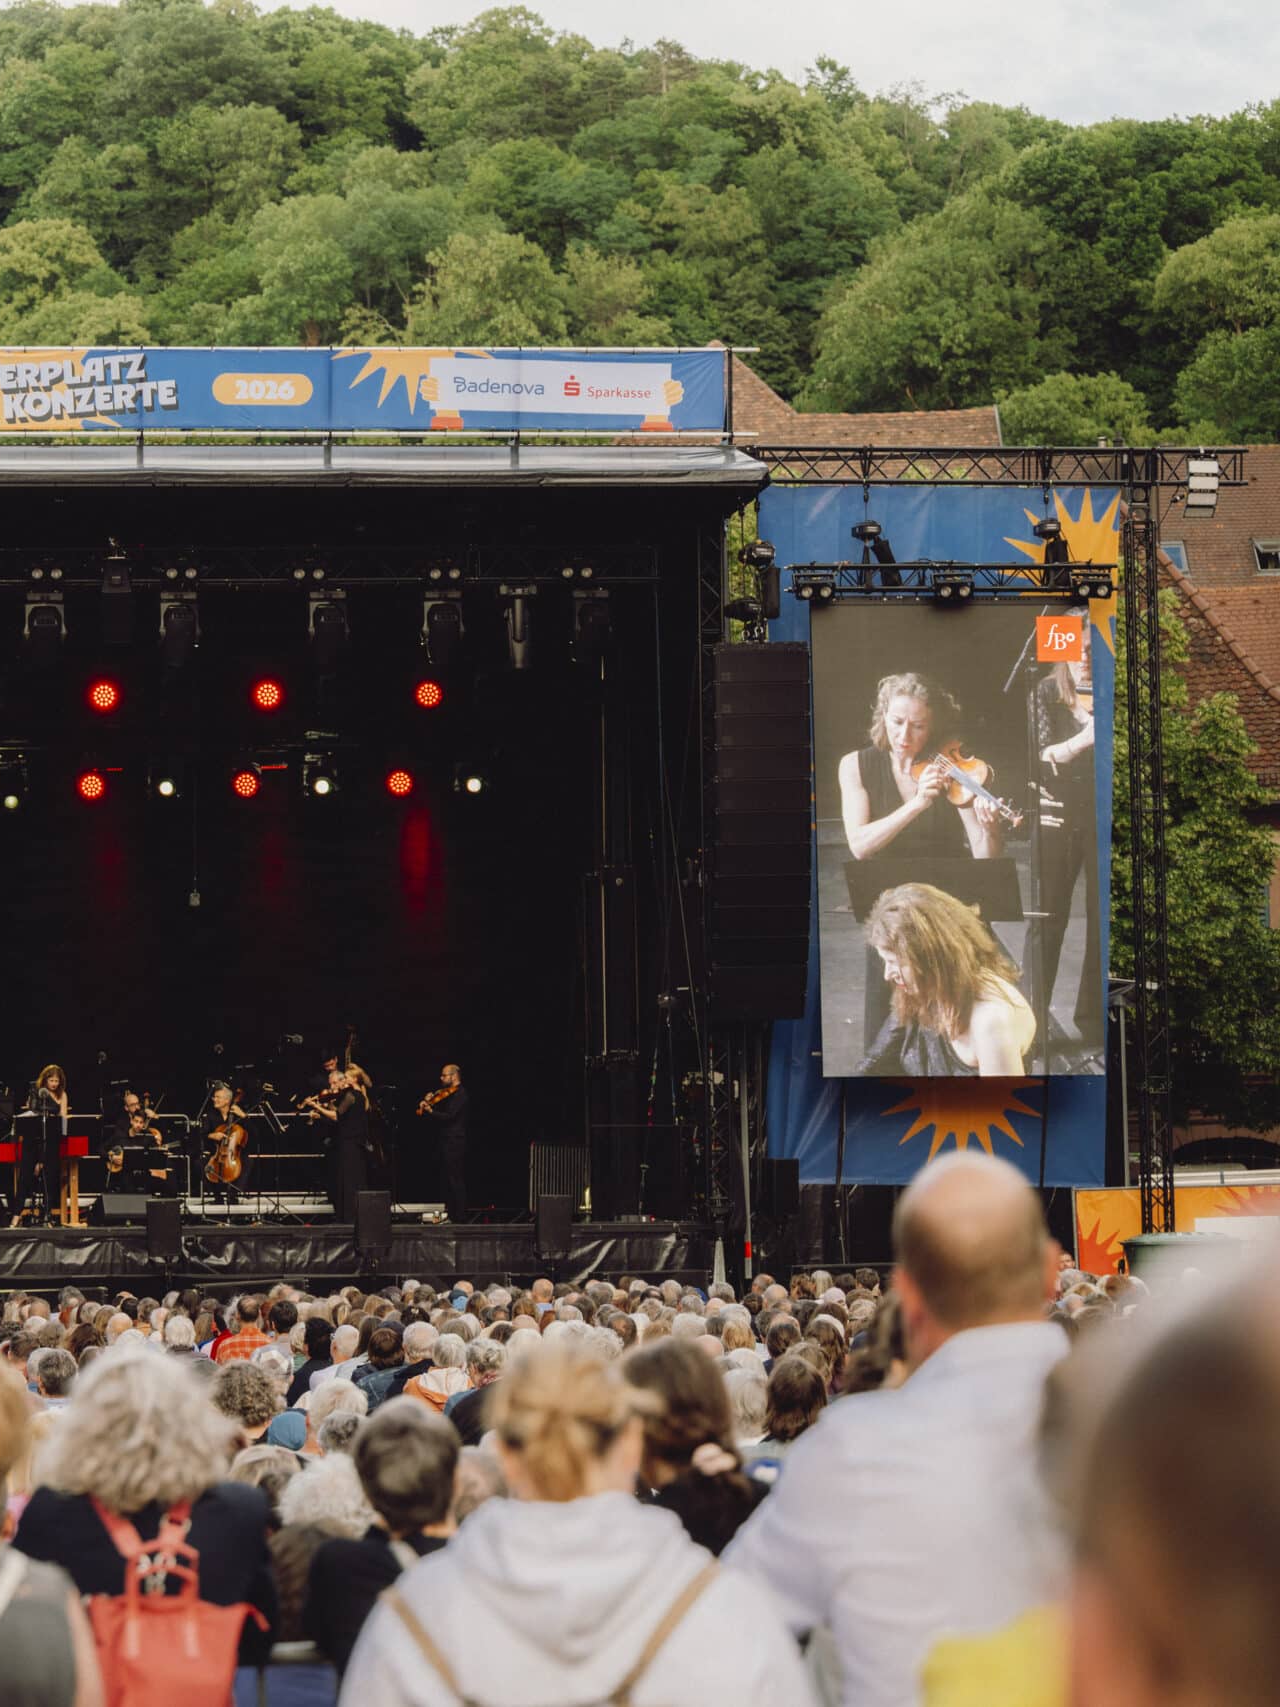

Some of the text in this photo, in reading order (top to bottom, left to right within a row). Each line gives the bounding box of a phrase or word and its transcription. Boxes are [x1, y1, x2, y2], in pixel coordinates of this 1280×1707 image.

[235, 379, 295, 400] 2026
[453, 376, 545, 395] Badenova
[587, 386, 651, 399] Sparkasse
[3, 380, 178, 421] KONZERTE
